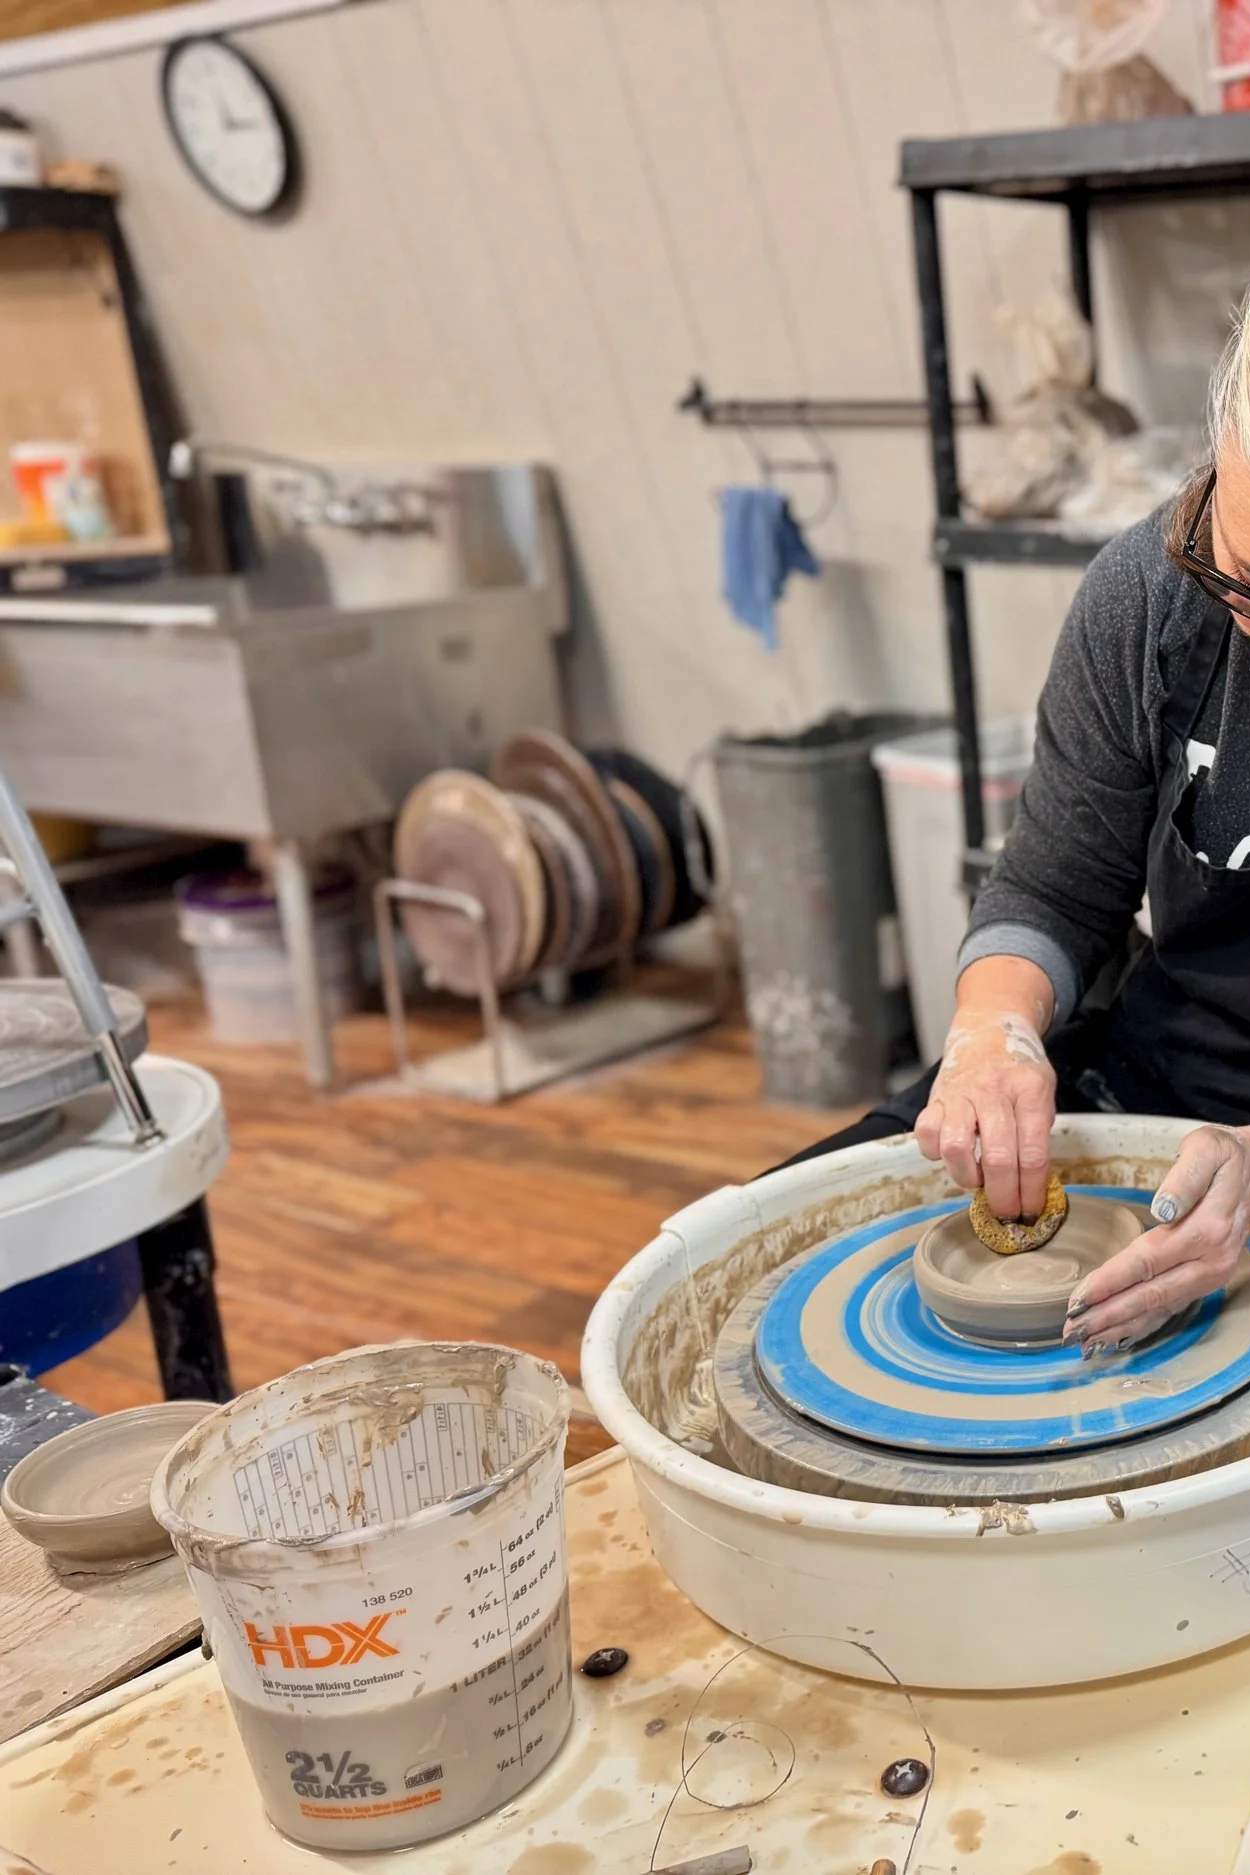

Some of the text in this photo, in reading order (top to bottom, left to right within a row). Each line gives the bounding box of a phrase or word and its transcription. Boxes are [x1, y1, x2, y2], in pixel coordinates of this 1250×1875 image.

[508, 1535, 523, 1552] 64
[510, 1556, 525, 1574] 56
[362, 1586, 413, 1608] 138 520
[513, 1585, 527, 1601] 48
[515, 1615, 530, 1632] 40
[244, 1612, 400, 1668] HDX
[518, 1644, 533, 1661] 32
[262, 1670, 405, 1693] All Purpose Mixing Container
[450, 1656, 506, 1693] 1 LITER
[521, 1672, 535, 1691] 24
[524, 1705, 536, 1721] 16
[526, 1743, 533, 1754] 8
[293, 1780, 387, 1799] QUARTS
